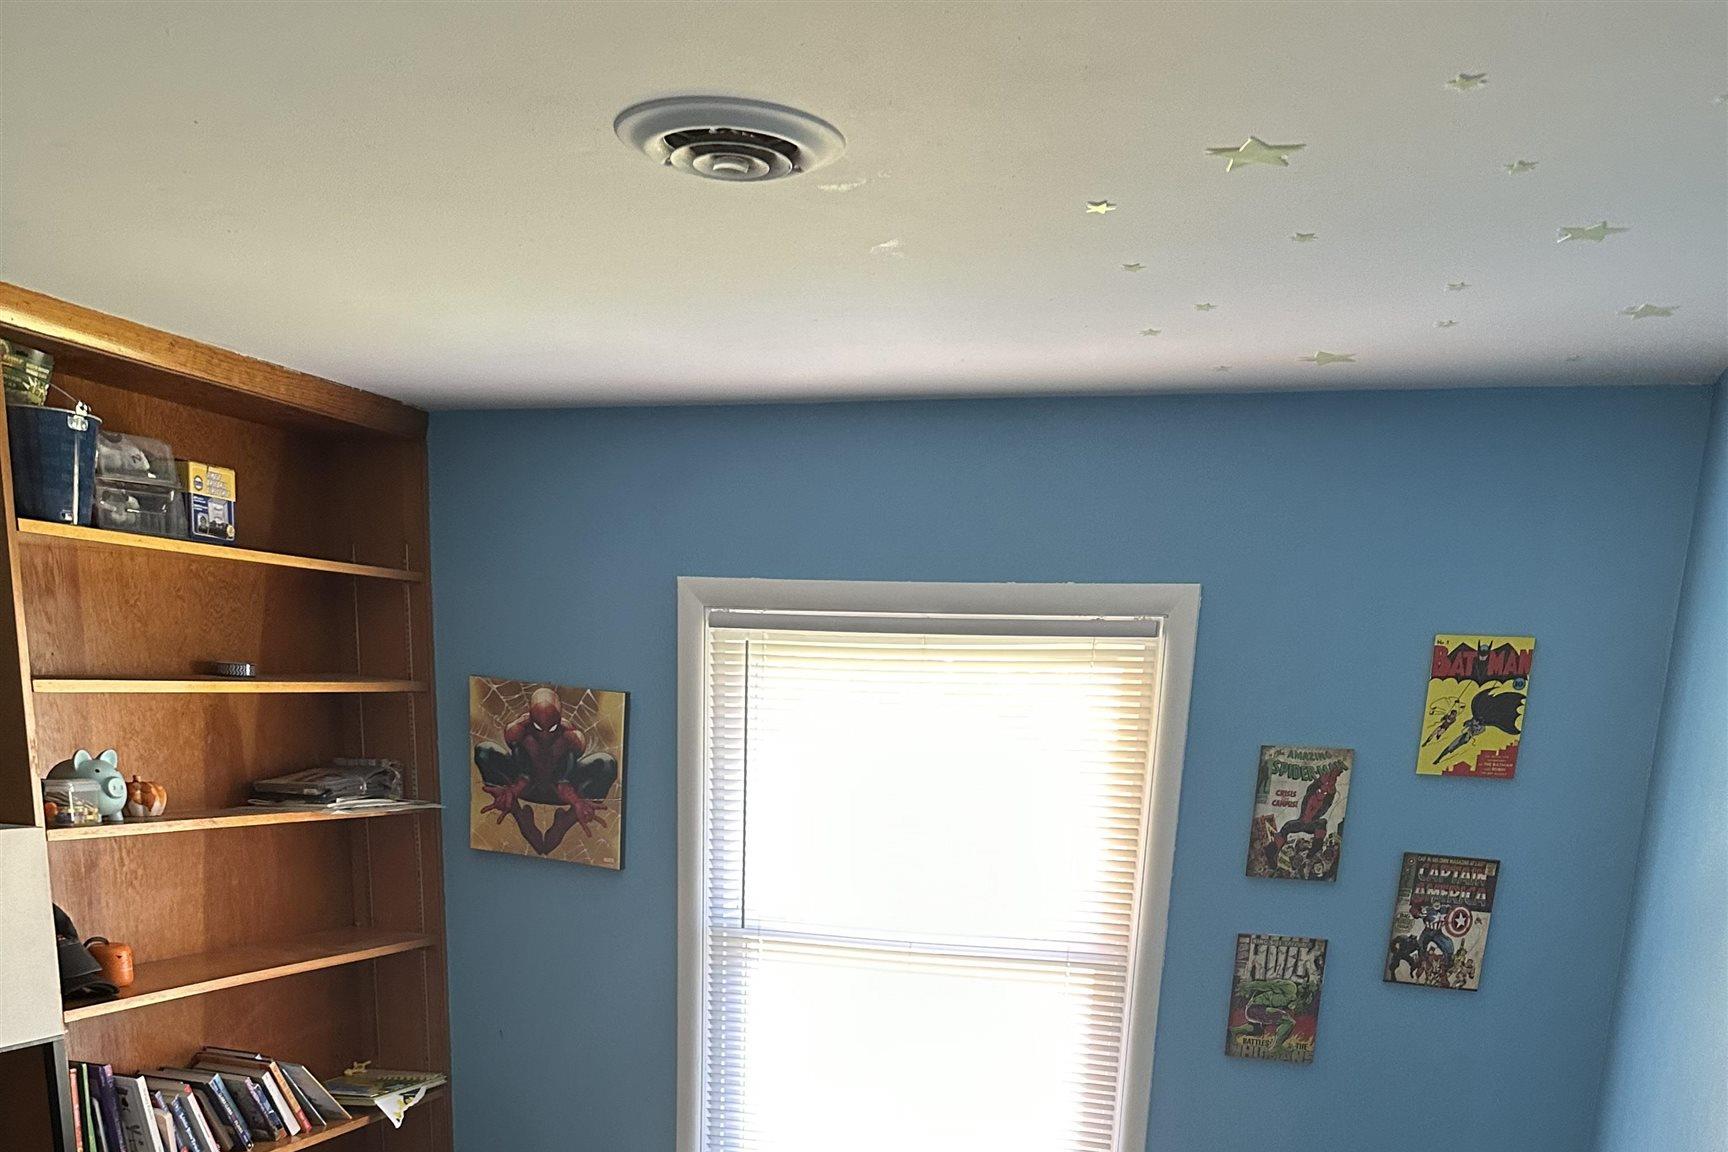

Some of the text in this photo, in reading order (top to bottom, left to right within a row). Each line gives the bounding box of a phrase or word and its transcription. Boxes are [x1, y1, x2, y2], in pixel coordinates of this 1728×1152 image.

[1431, 644, 1533, 678] BATMAN
[1286, 749, 1333, 761] AMAZING
[1417, 862, 1487, 886] CAPTAIN
[1411, 881, 1487, 907] AMERICA
[1245, 943, 1321, 985] HULK
